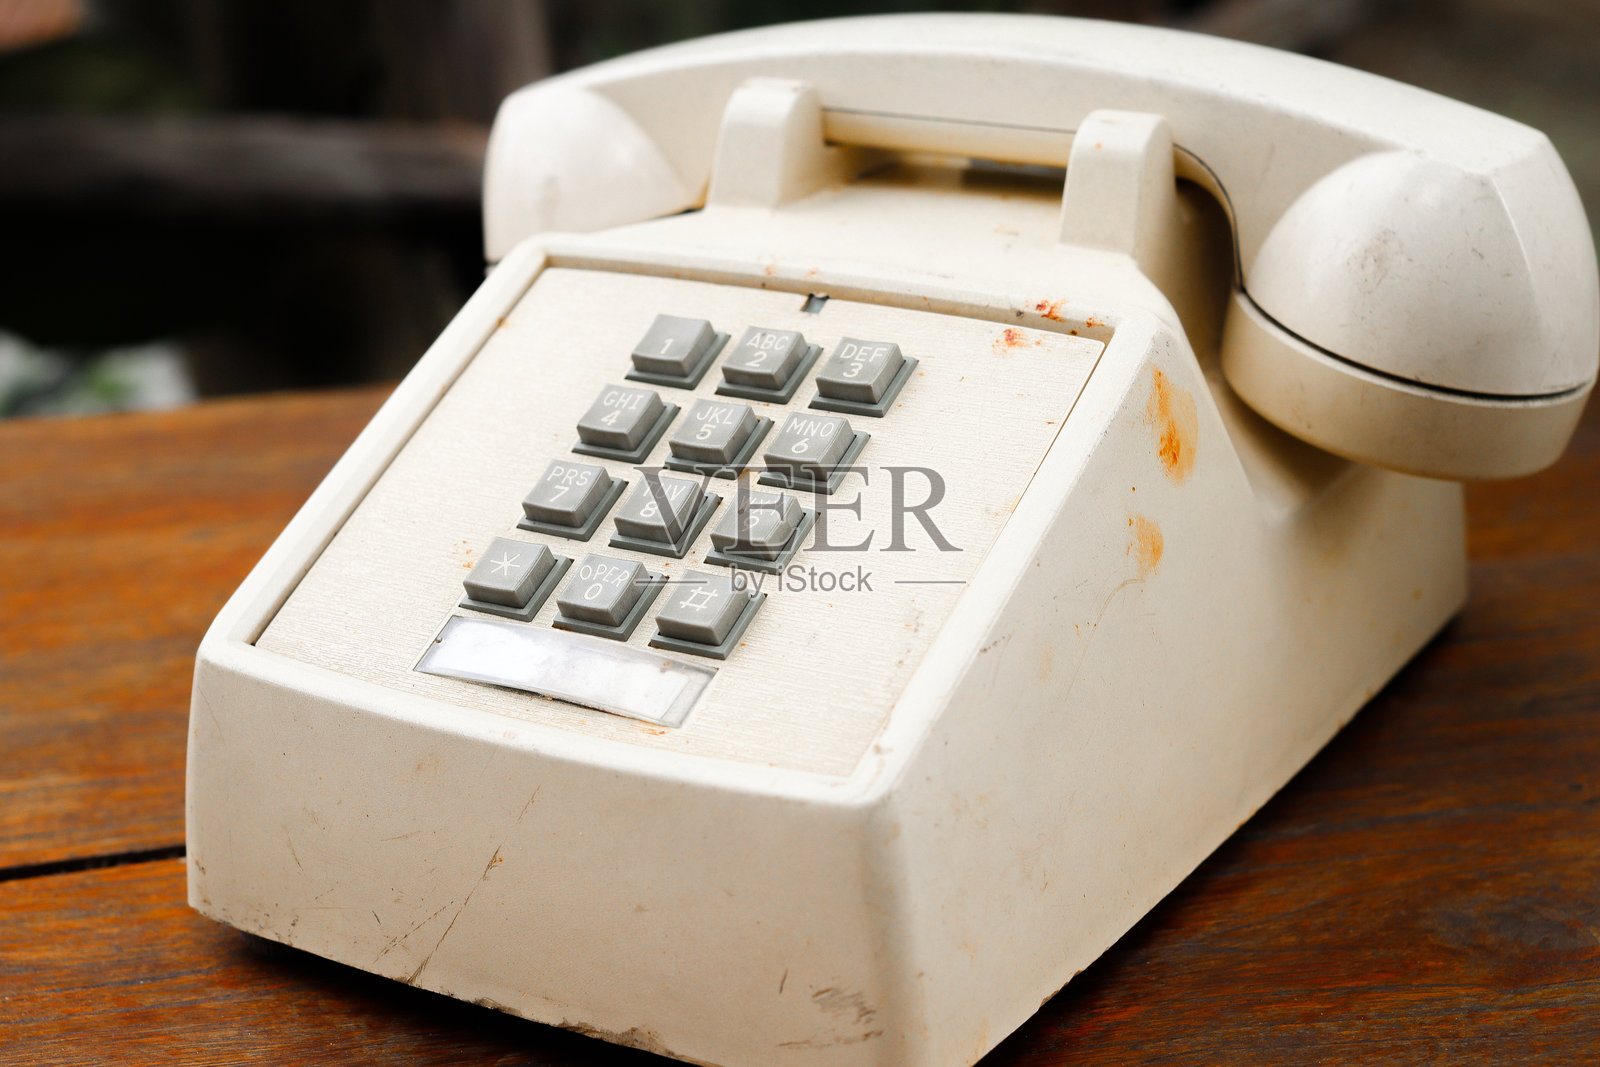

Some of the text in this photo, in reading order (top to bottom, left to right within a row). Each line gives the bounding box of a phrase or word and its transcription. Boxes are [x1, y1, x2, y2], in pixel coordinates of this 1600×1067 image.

[660, 338, 671, 354] 1
[747, 332, 789, 350] ABC
[746, 353, 767, 367] 2
[840, 344, 887, 362] DEF
[843, 363, 860, 378] 3
[603, 391, 644, 410] GHI
[600, 410, 621, 426] 4
[696, 406, 733, 426] JKL
[695, 424, 716, 440] 5
[786, 416, 835, 438] MNO
[791, 438, 809, 454] 6
[547, 466, 592, 487] PRS
[549, 486, 570, 502] 7
[640, 500, 659, 517] 8
[579, 563, 631, 588] OPER
